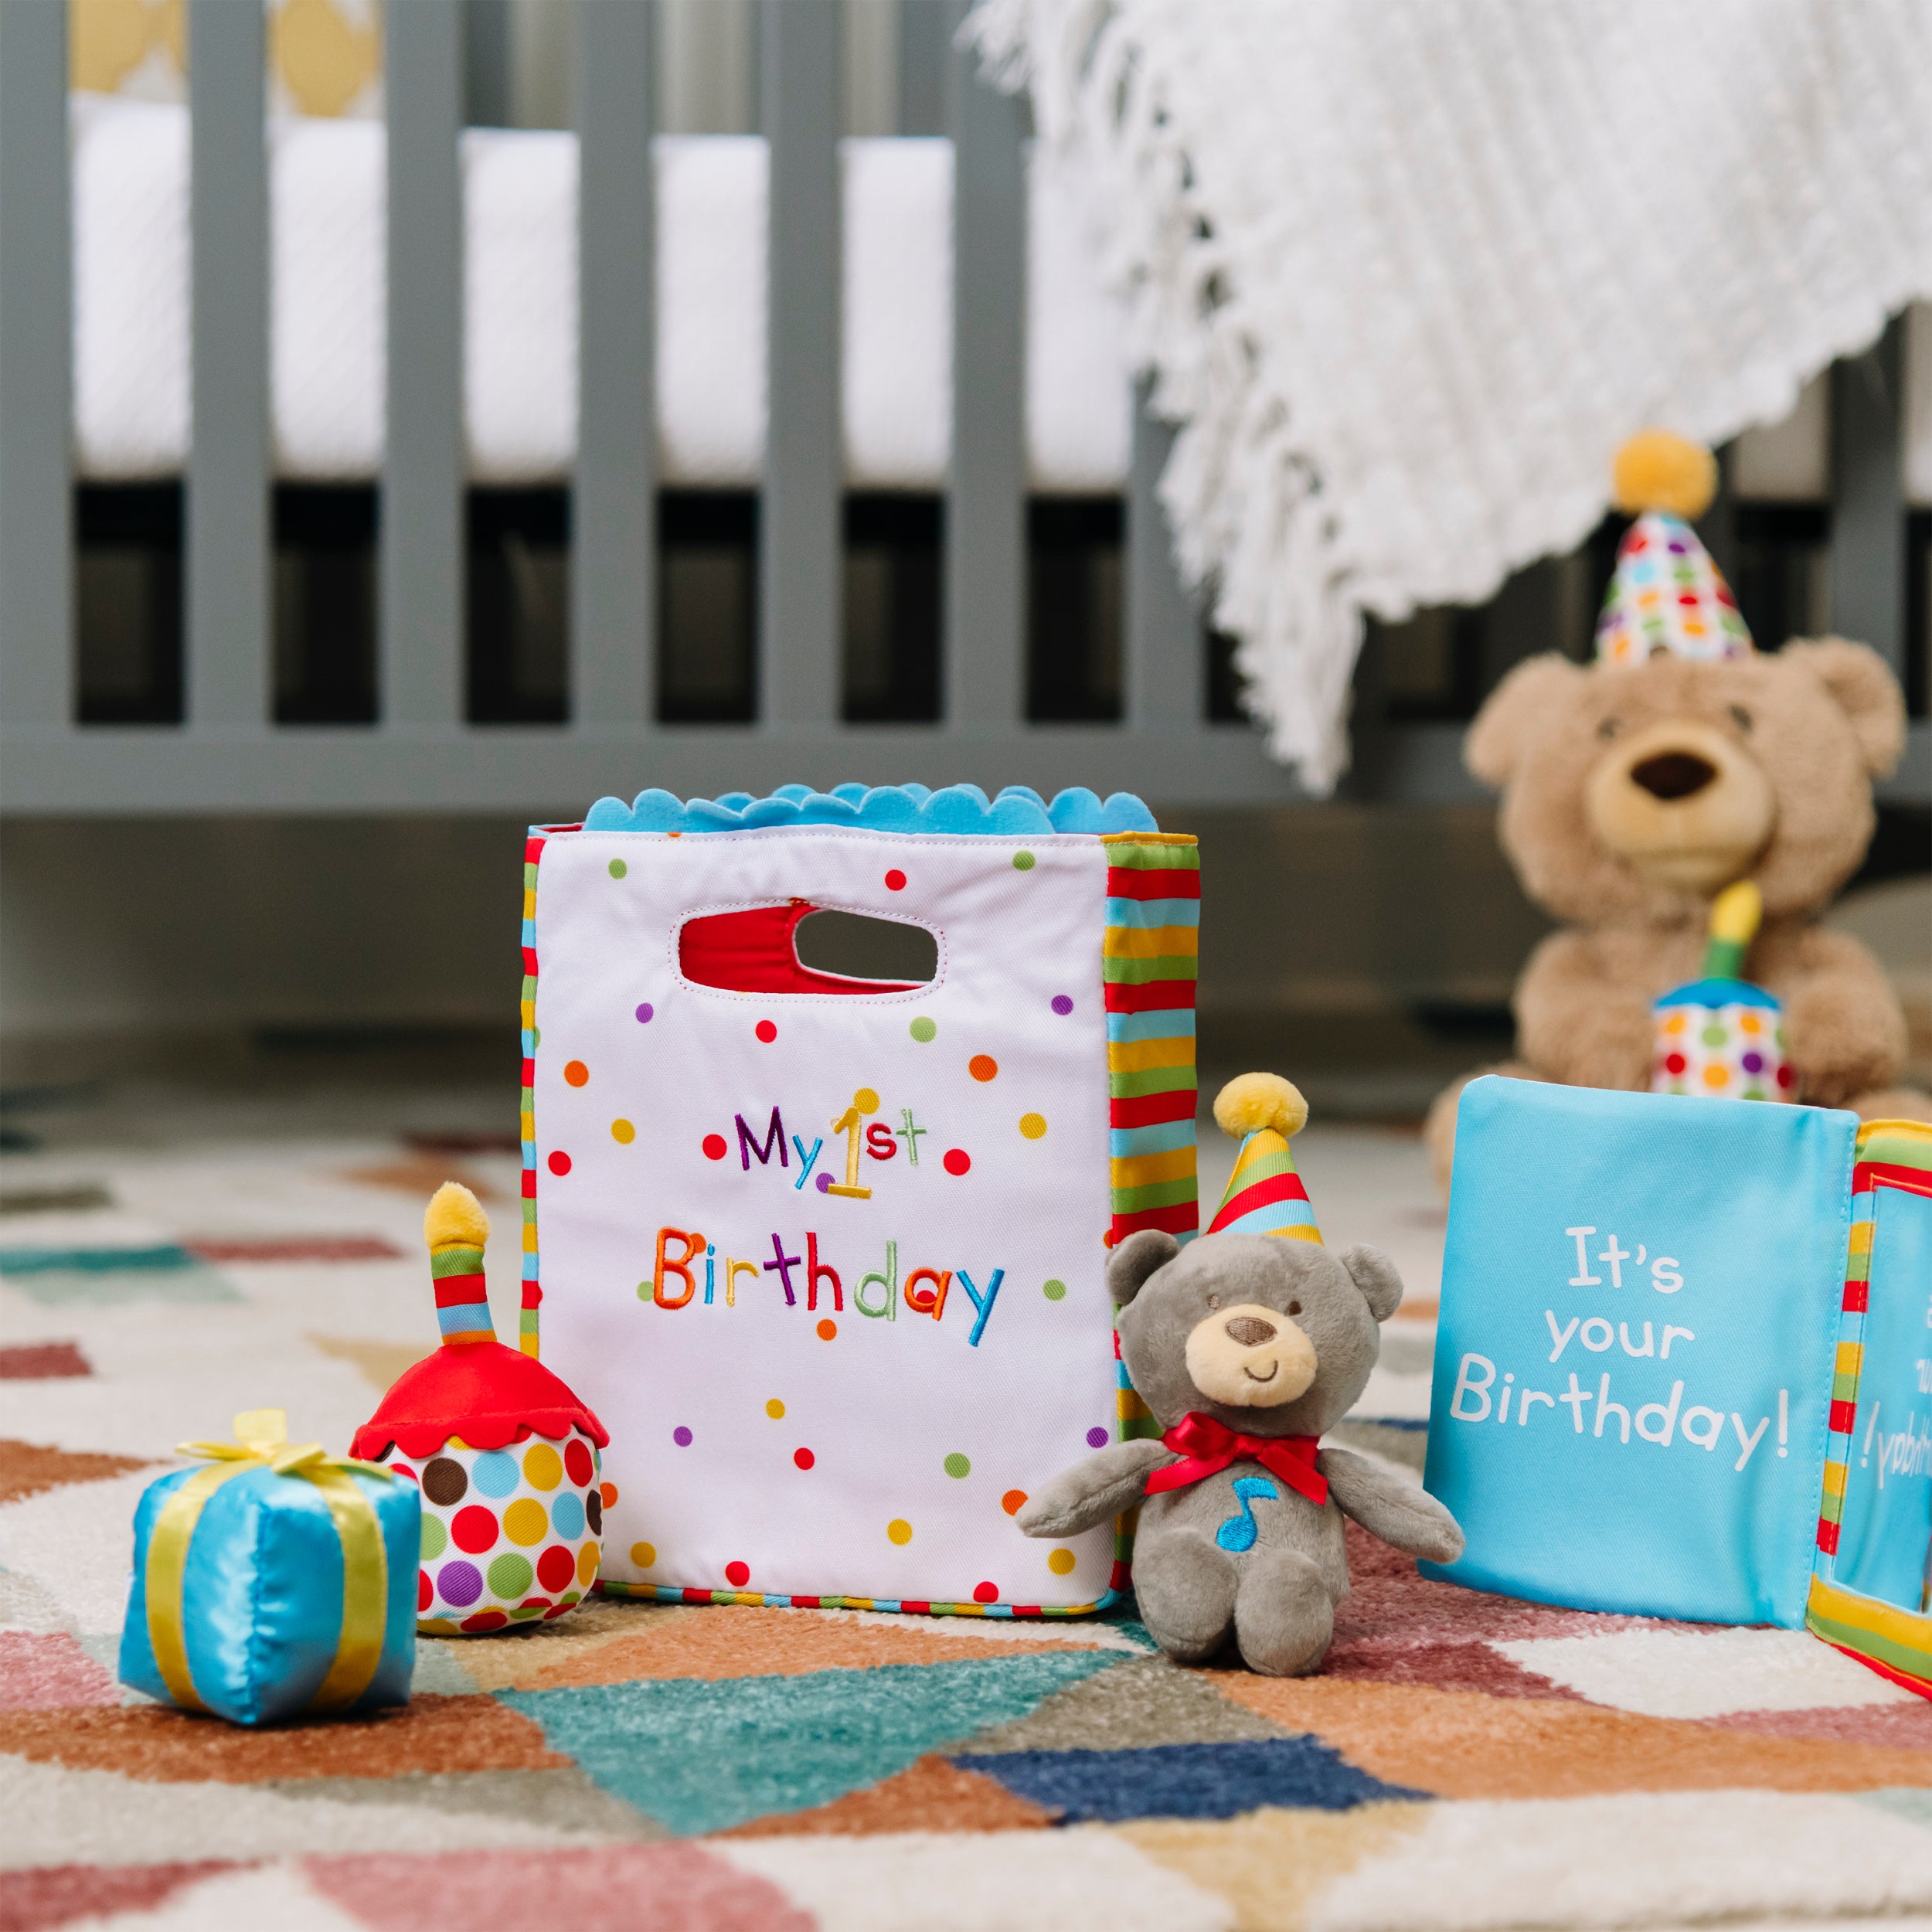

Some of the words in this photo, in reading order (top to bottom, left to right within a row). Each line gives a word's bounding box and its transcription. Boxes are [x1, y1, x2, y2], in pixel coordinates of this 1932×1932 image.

[734, 1105, 823, 1190] My
[828, 1105, 927, 1199] 1st
[654, 1226, 1005, 1347] Birthday
[1566, 1226, 1683, 1294] It's
[1546, 1310, 1695, 1362] your
[1450, 1353, 1788, 1471] Birthday!
